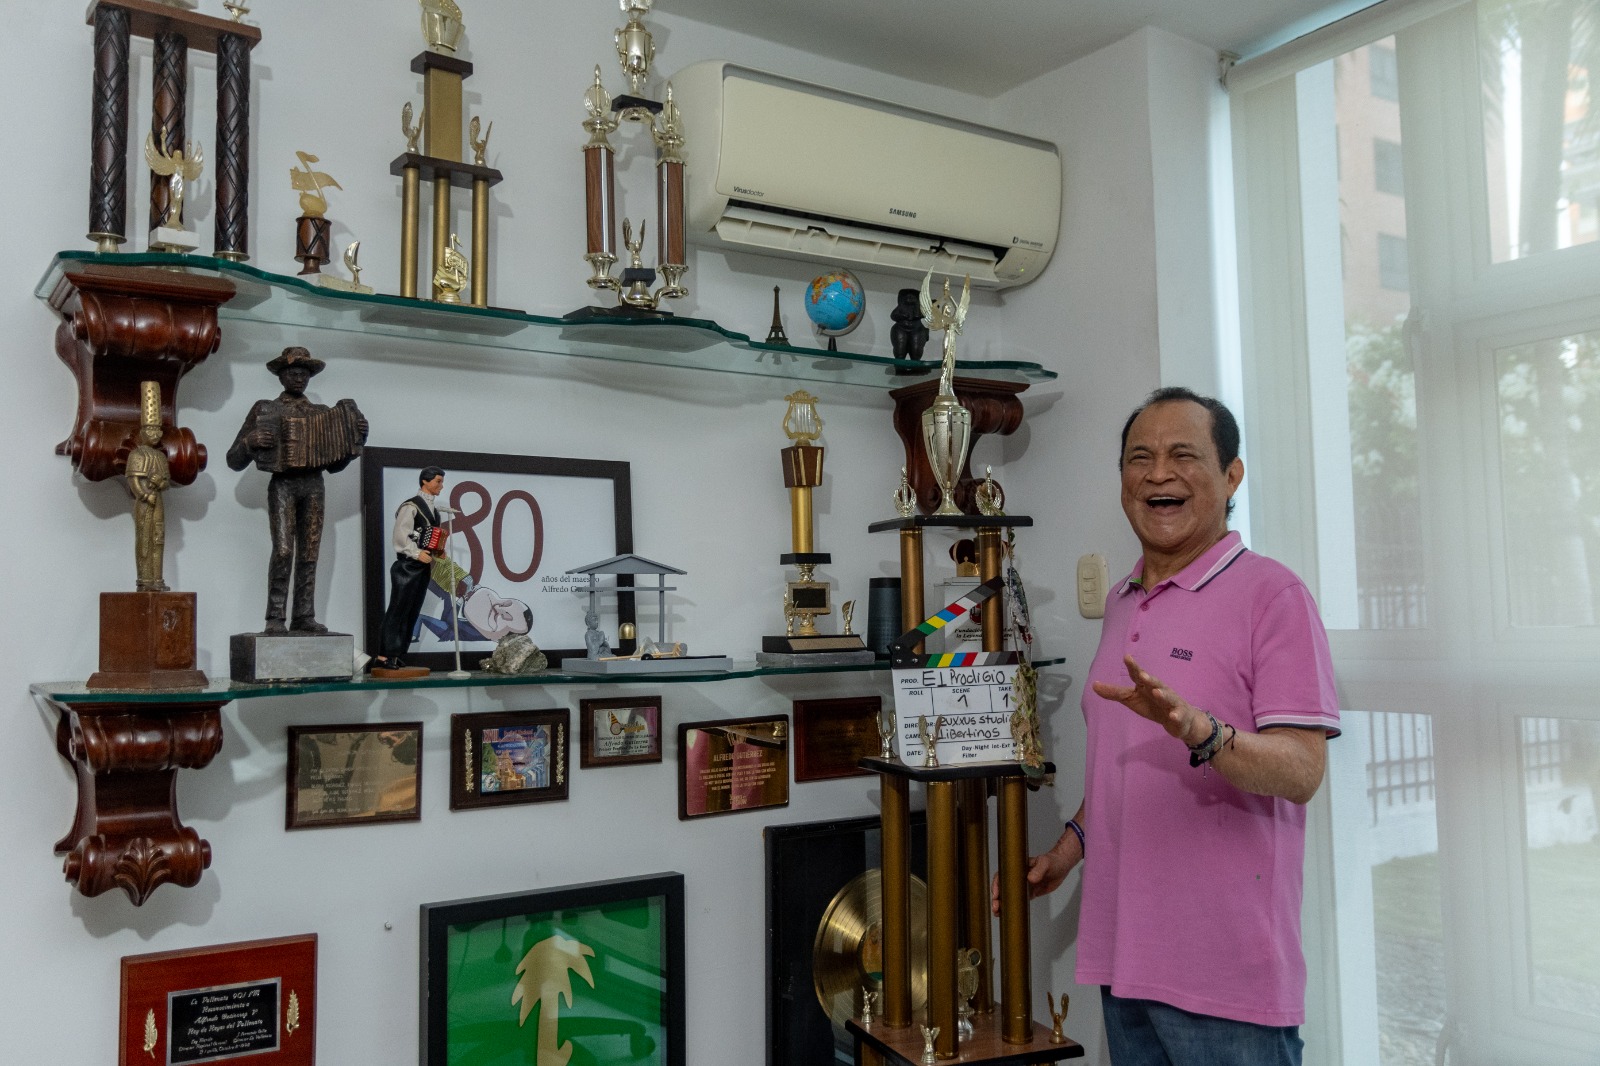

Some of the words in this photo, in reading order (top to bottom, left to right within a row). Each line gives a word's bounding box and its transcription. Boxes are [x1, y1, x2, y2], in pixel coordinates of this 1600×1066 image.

[733, 186, 764, 197] Virusdoctor
[888, 207, 917, 219] SAMSUNG
[436, 480, 544, 598] 80
[541, 575, 558, 583] años
[559, 575, 571, 583] del
[572, 575, 600, 583] maeso
[541, 585, 569, 593] Alfredo
[1172, 648, 1193, 657] BOSS
[904, 721, 935, 730] DIREOR:
